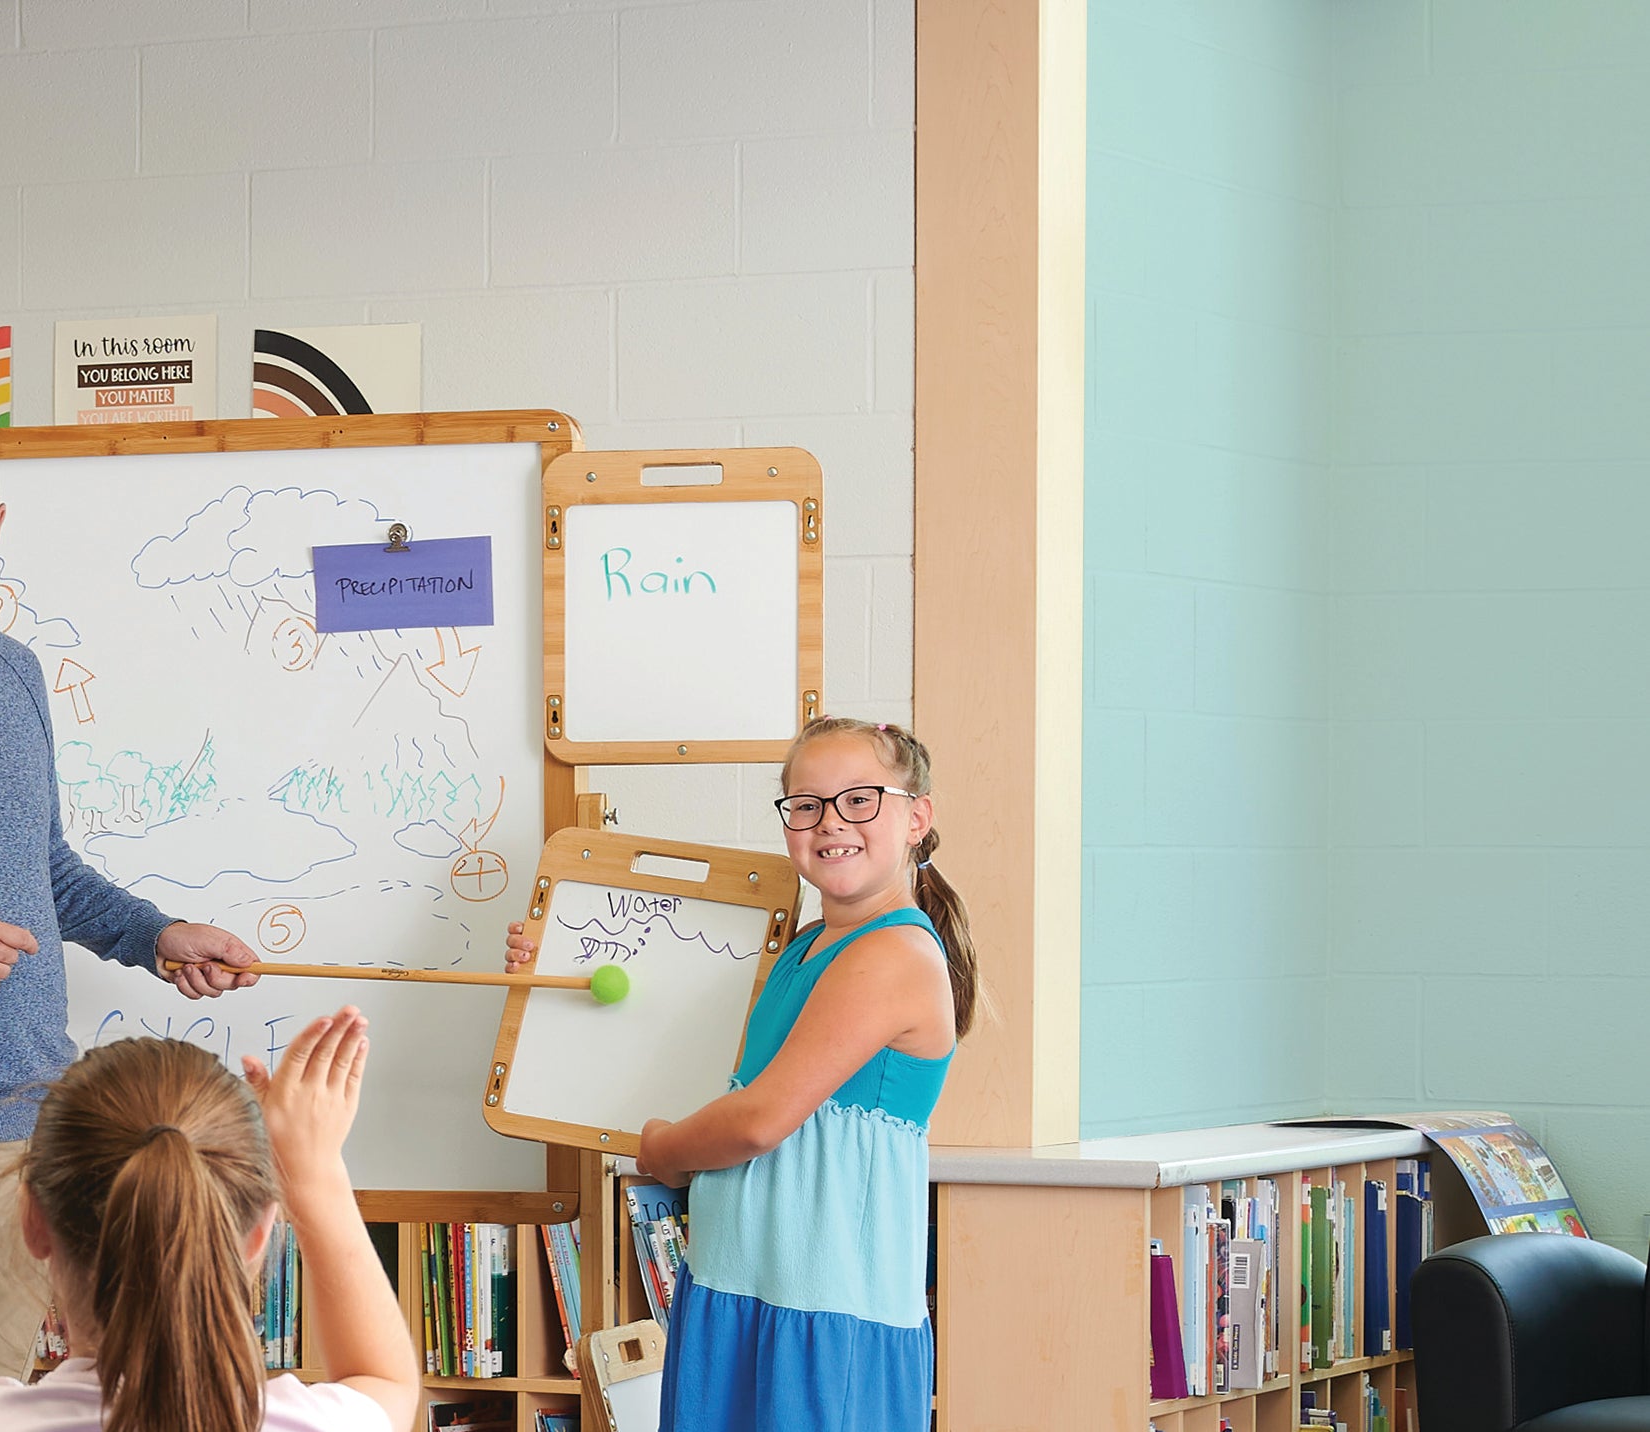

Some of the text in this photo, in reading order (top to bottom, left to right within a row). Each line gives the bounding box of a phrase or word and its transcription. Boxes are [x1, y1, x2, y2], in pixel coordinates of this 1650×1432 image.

[74, 337, 196, 358] In this room
[80, 365, 191, 383] YOU BELONG HERE
[98, 389, 173, 405] YOU MATTER
[81, 412, 109, 425] YOU
[335, 568, 473, 603] PRECIPITATION
[600, 547, 716, 600] Rain
[288, 628, 304, 666] 3
[453, 856, 503, 894] 4
[607, 892, 682, 917] Water
[268, 909, 303, 947] 5
